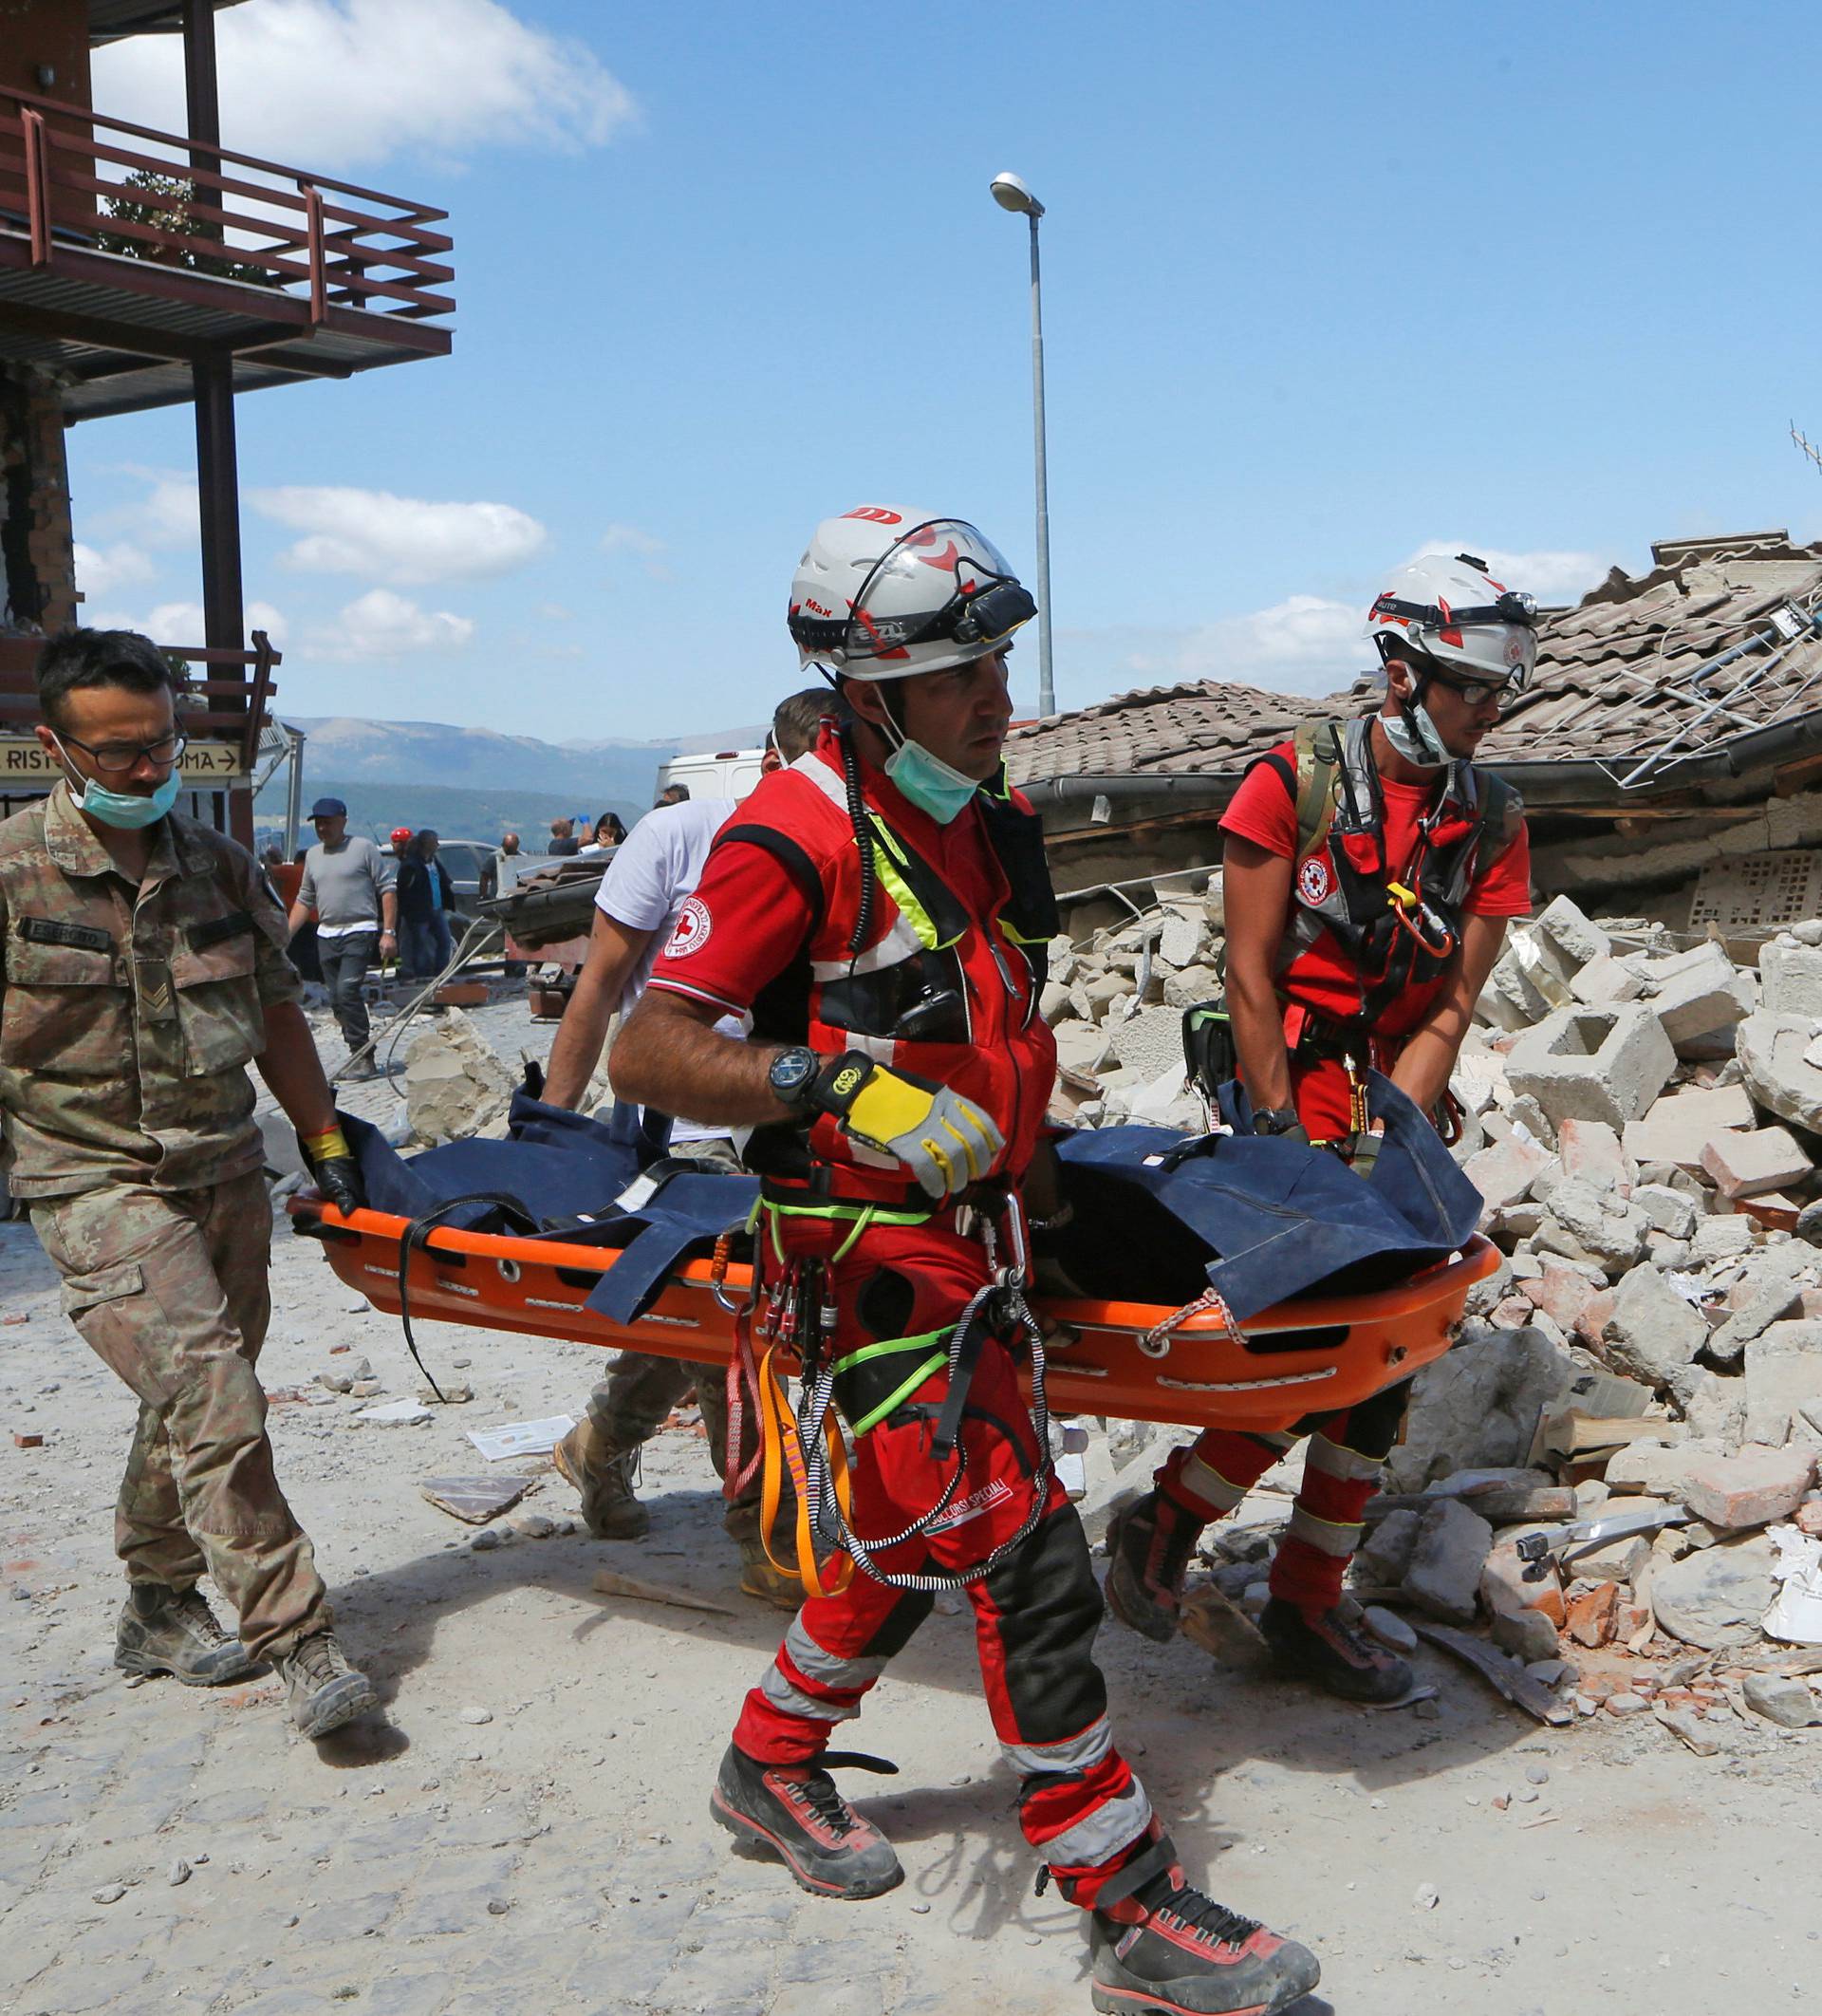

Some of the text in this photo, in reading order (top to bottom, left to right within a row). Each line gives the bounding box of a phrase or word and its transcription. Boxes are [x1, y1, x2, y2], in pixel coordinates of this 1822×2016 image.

[805, 598, 832, 618] Max
[8, 750, 62, 770] RIST
[968, 1477, 1008, 1507] SPECIALI
